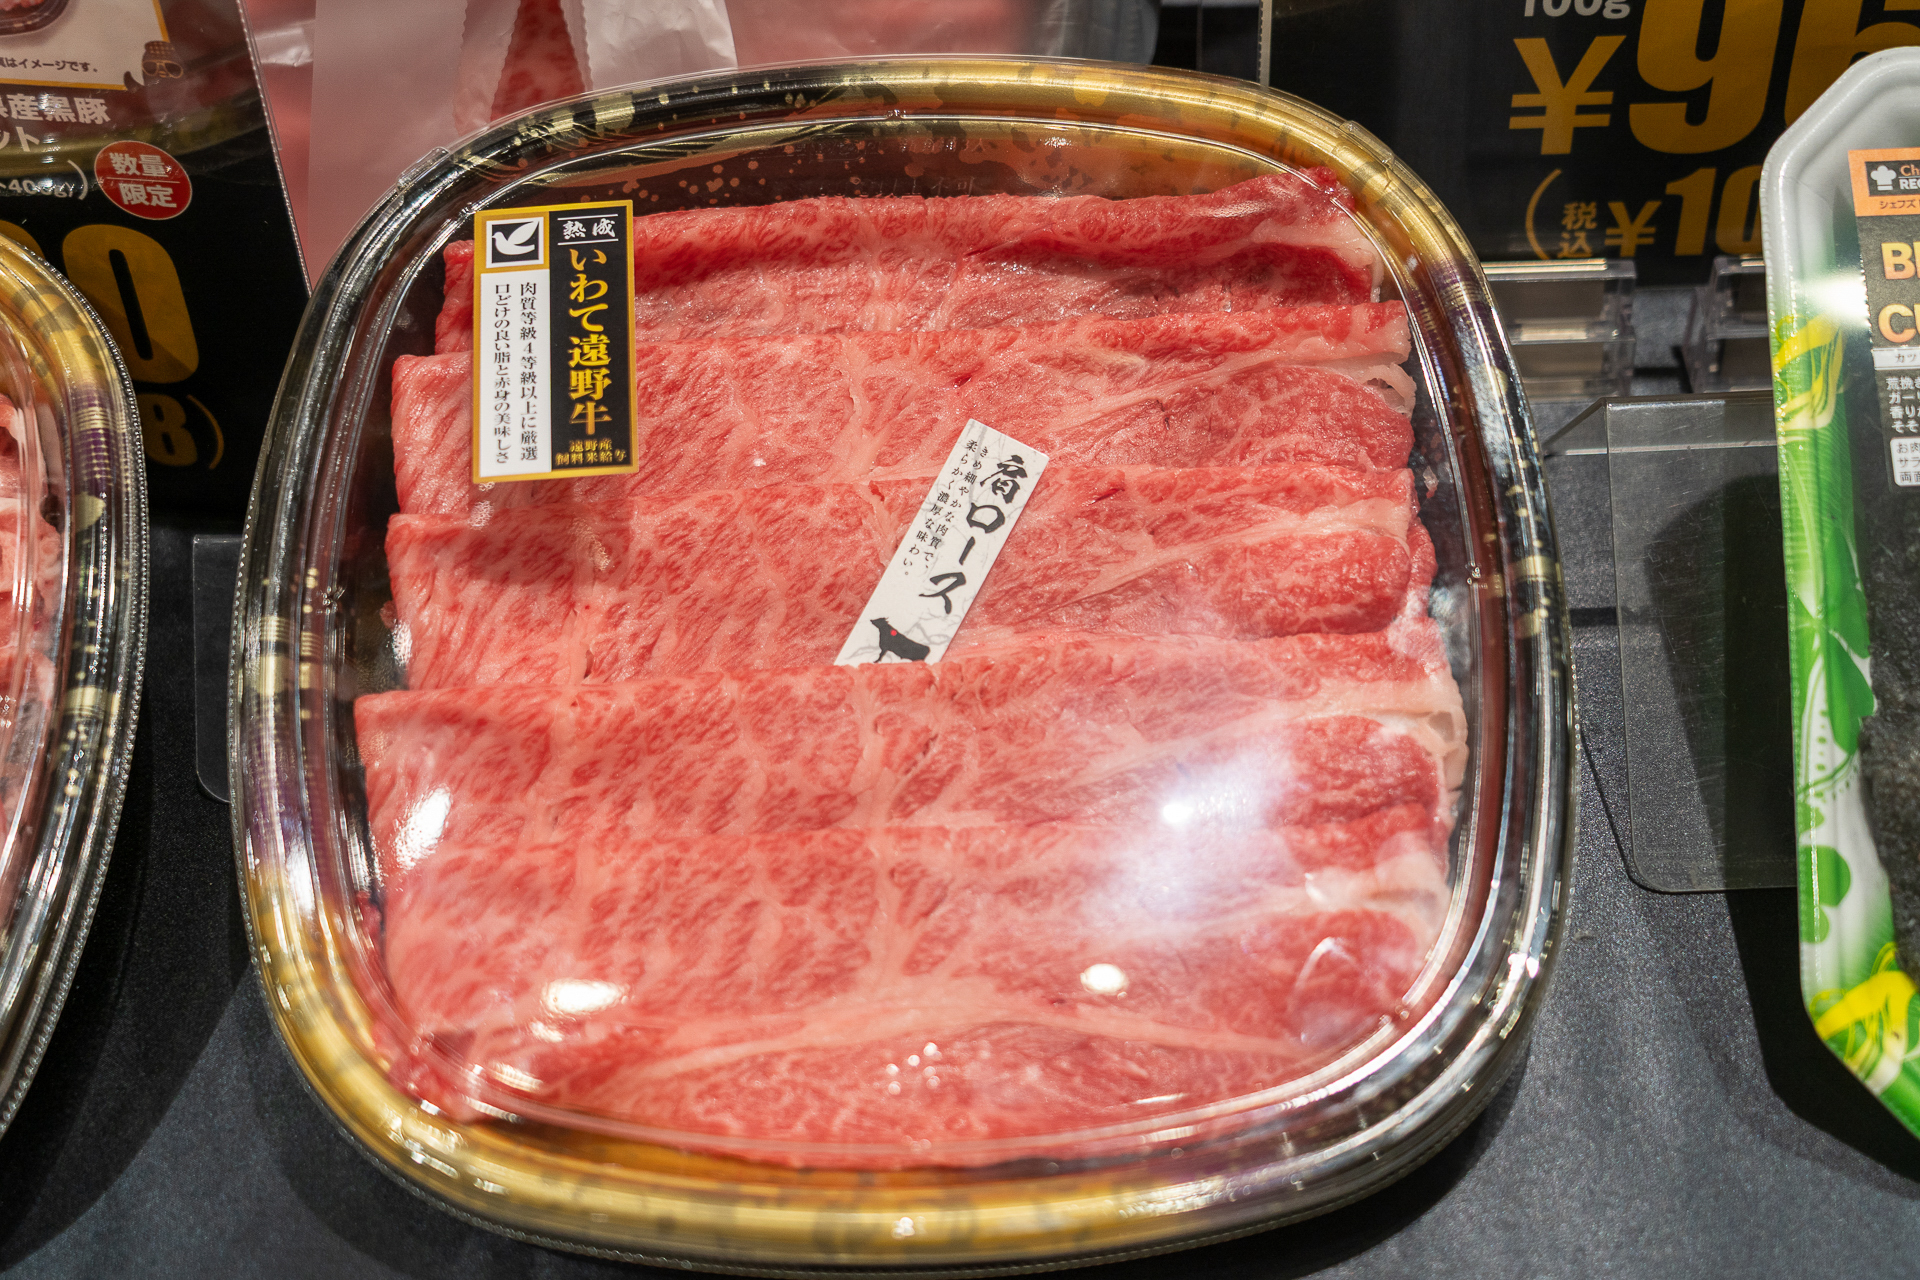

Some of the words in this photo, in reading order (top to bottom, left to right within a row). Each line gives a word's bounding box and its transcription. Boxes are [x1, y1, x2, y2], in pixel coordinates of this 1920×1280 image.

[0, 93, 111, 125] 産黒豚
[109, 152, 171, 178] 数量
[119, 183, 178, 209] 限定
[563, 218, 616, 240] 熟成
[494, 283, 512, 464] 口どけの良い脂と赤身の美味しさ
[520, 282, 538, 461] 肉質等級4等級以上に厳選
[569, 248, 613, 436] いわて遠野牛
[903, 439, 978, 576] 柔らかく濃厚な味わい。
[918, 454, 1028, 614] 肩ロース
[923, 446, 989, 569] きめ細やかな肉質で、
